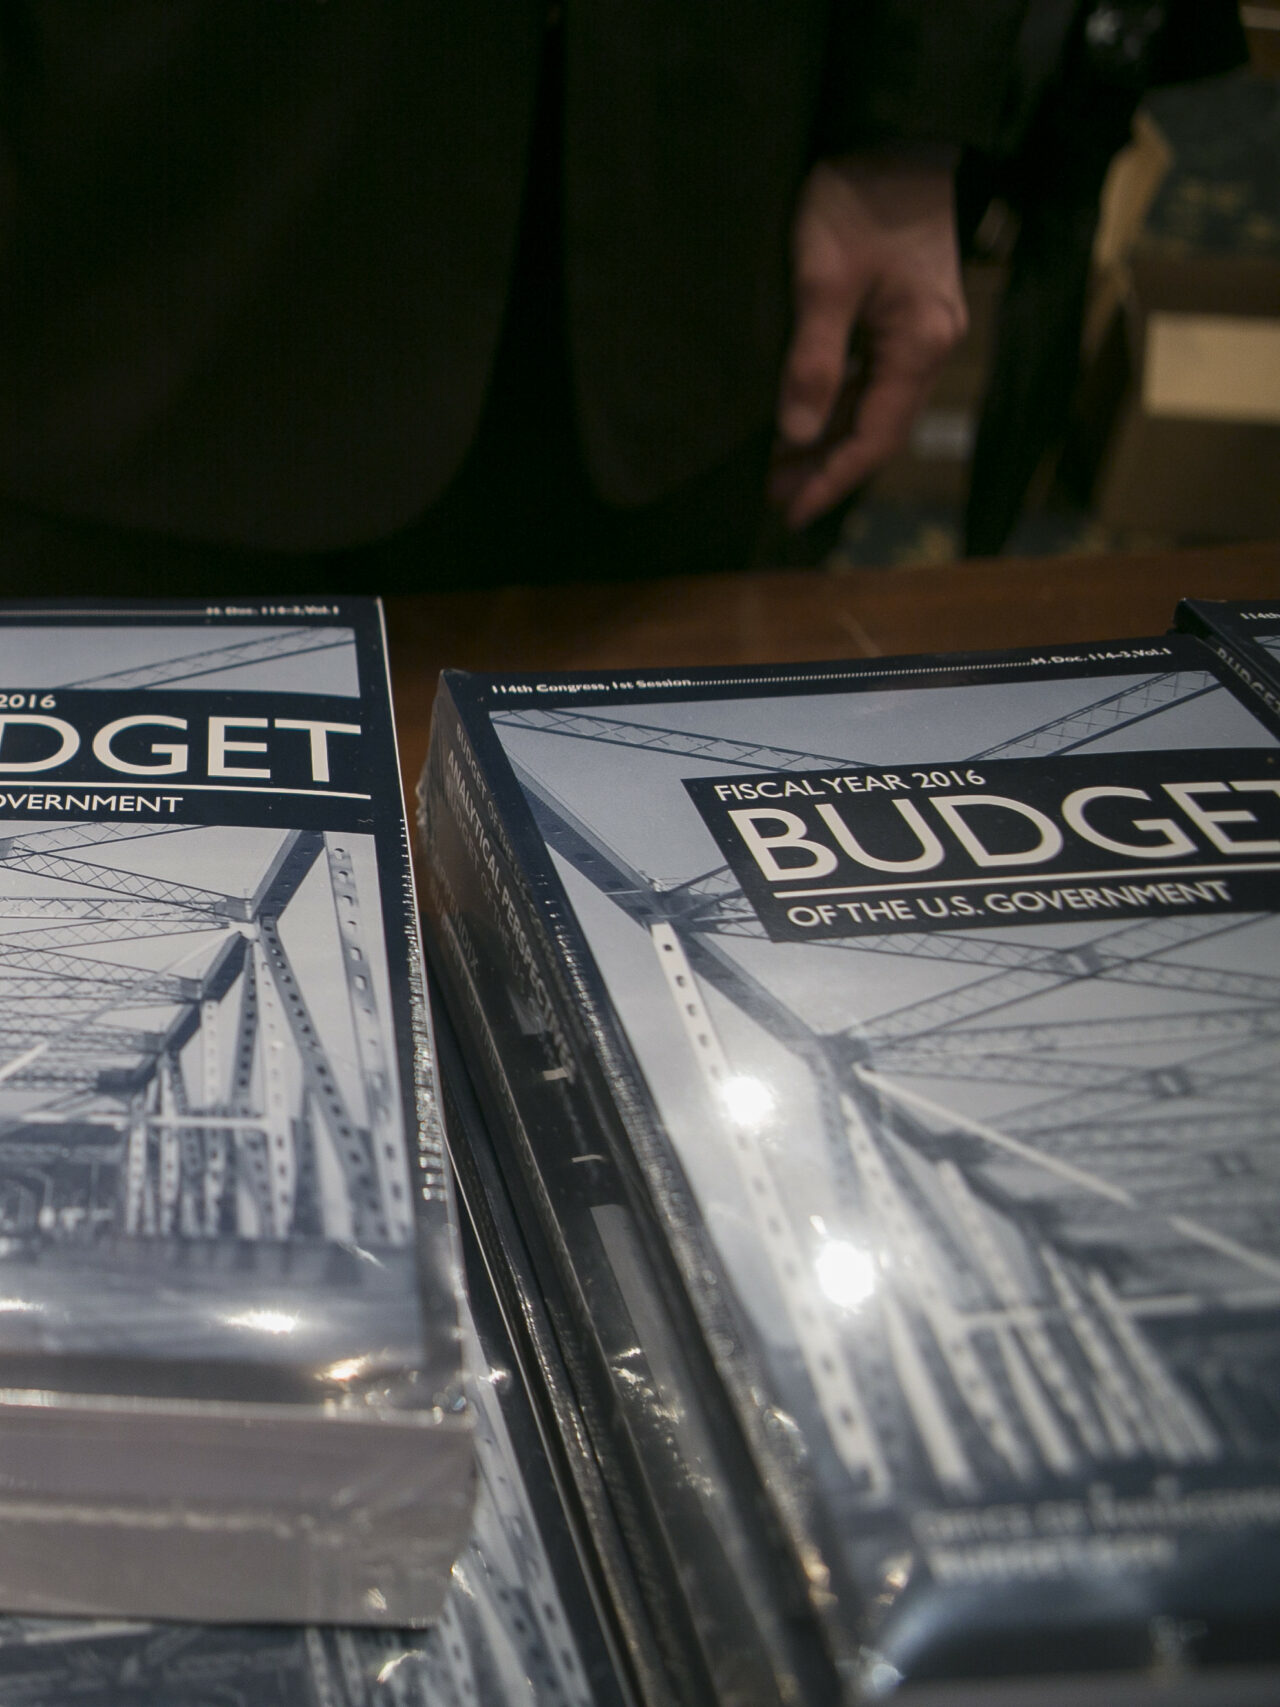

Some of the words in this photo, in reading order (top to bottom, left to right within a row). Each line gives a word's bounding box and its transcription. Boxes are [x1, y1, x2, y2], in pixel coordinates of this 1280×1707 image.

[491, 684, 533, 695] 114th
[536, 682, 610, 693] Congress,
[612, 680, 634, 690] 1st
[713, 779, 825, 801] FISCAL
[820, 773, 912, 794] YEAR
[911, 769, 987, 789] 2016
[447, 749, 500, 895] ANALYTICAL
[786, 903, 840, 928] OF
[836, 899, 918, 924] THE
[915, 895, 985, 918] U.S.
[983, 880, 1233, 915] GOVERNMENT
